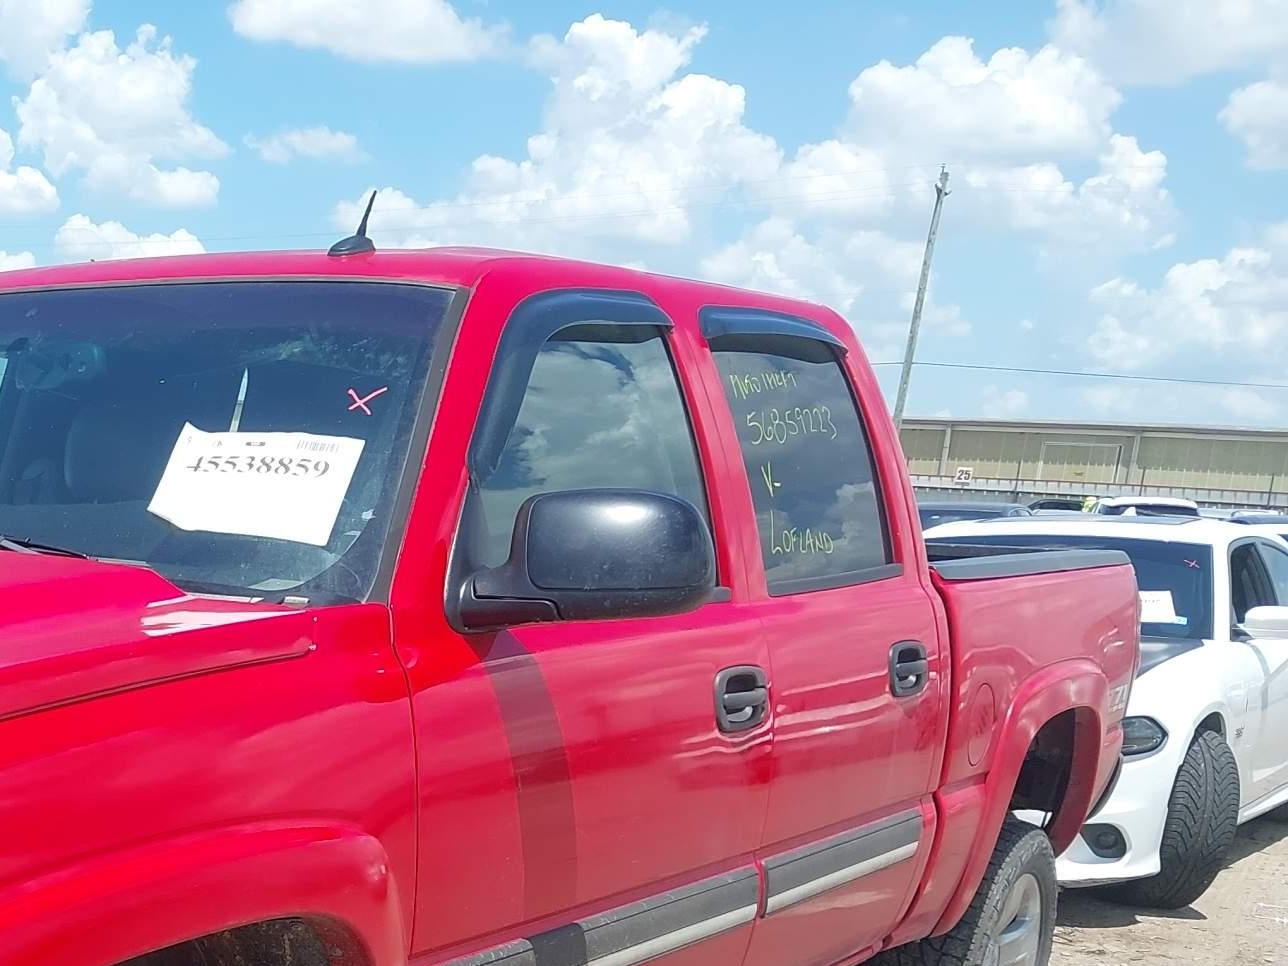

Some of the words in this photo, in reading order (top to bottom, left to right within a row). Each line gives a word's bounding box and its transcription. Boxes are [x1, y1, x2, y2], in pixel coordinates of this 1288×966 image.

[747, 406, 838, 445] 56859223
[186, 455, 330, 478] 45538859
[957, 469, 972, 481] 25
[770, 509, 834, 555] LOFLAND
